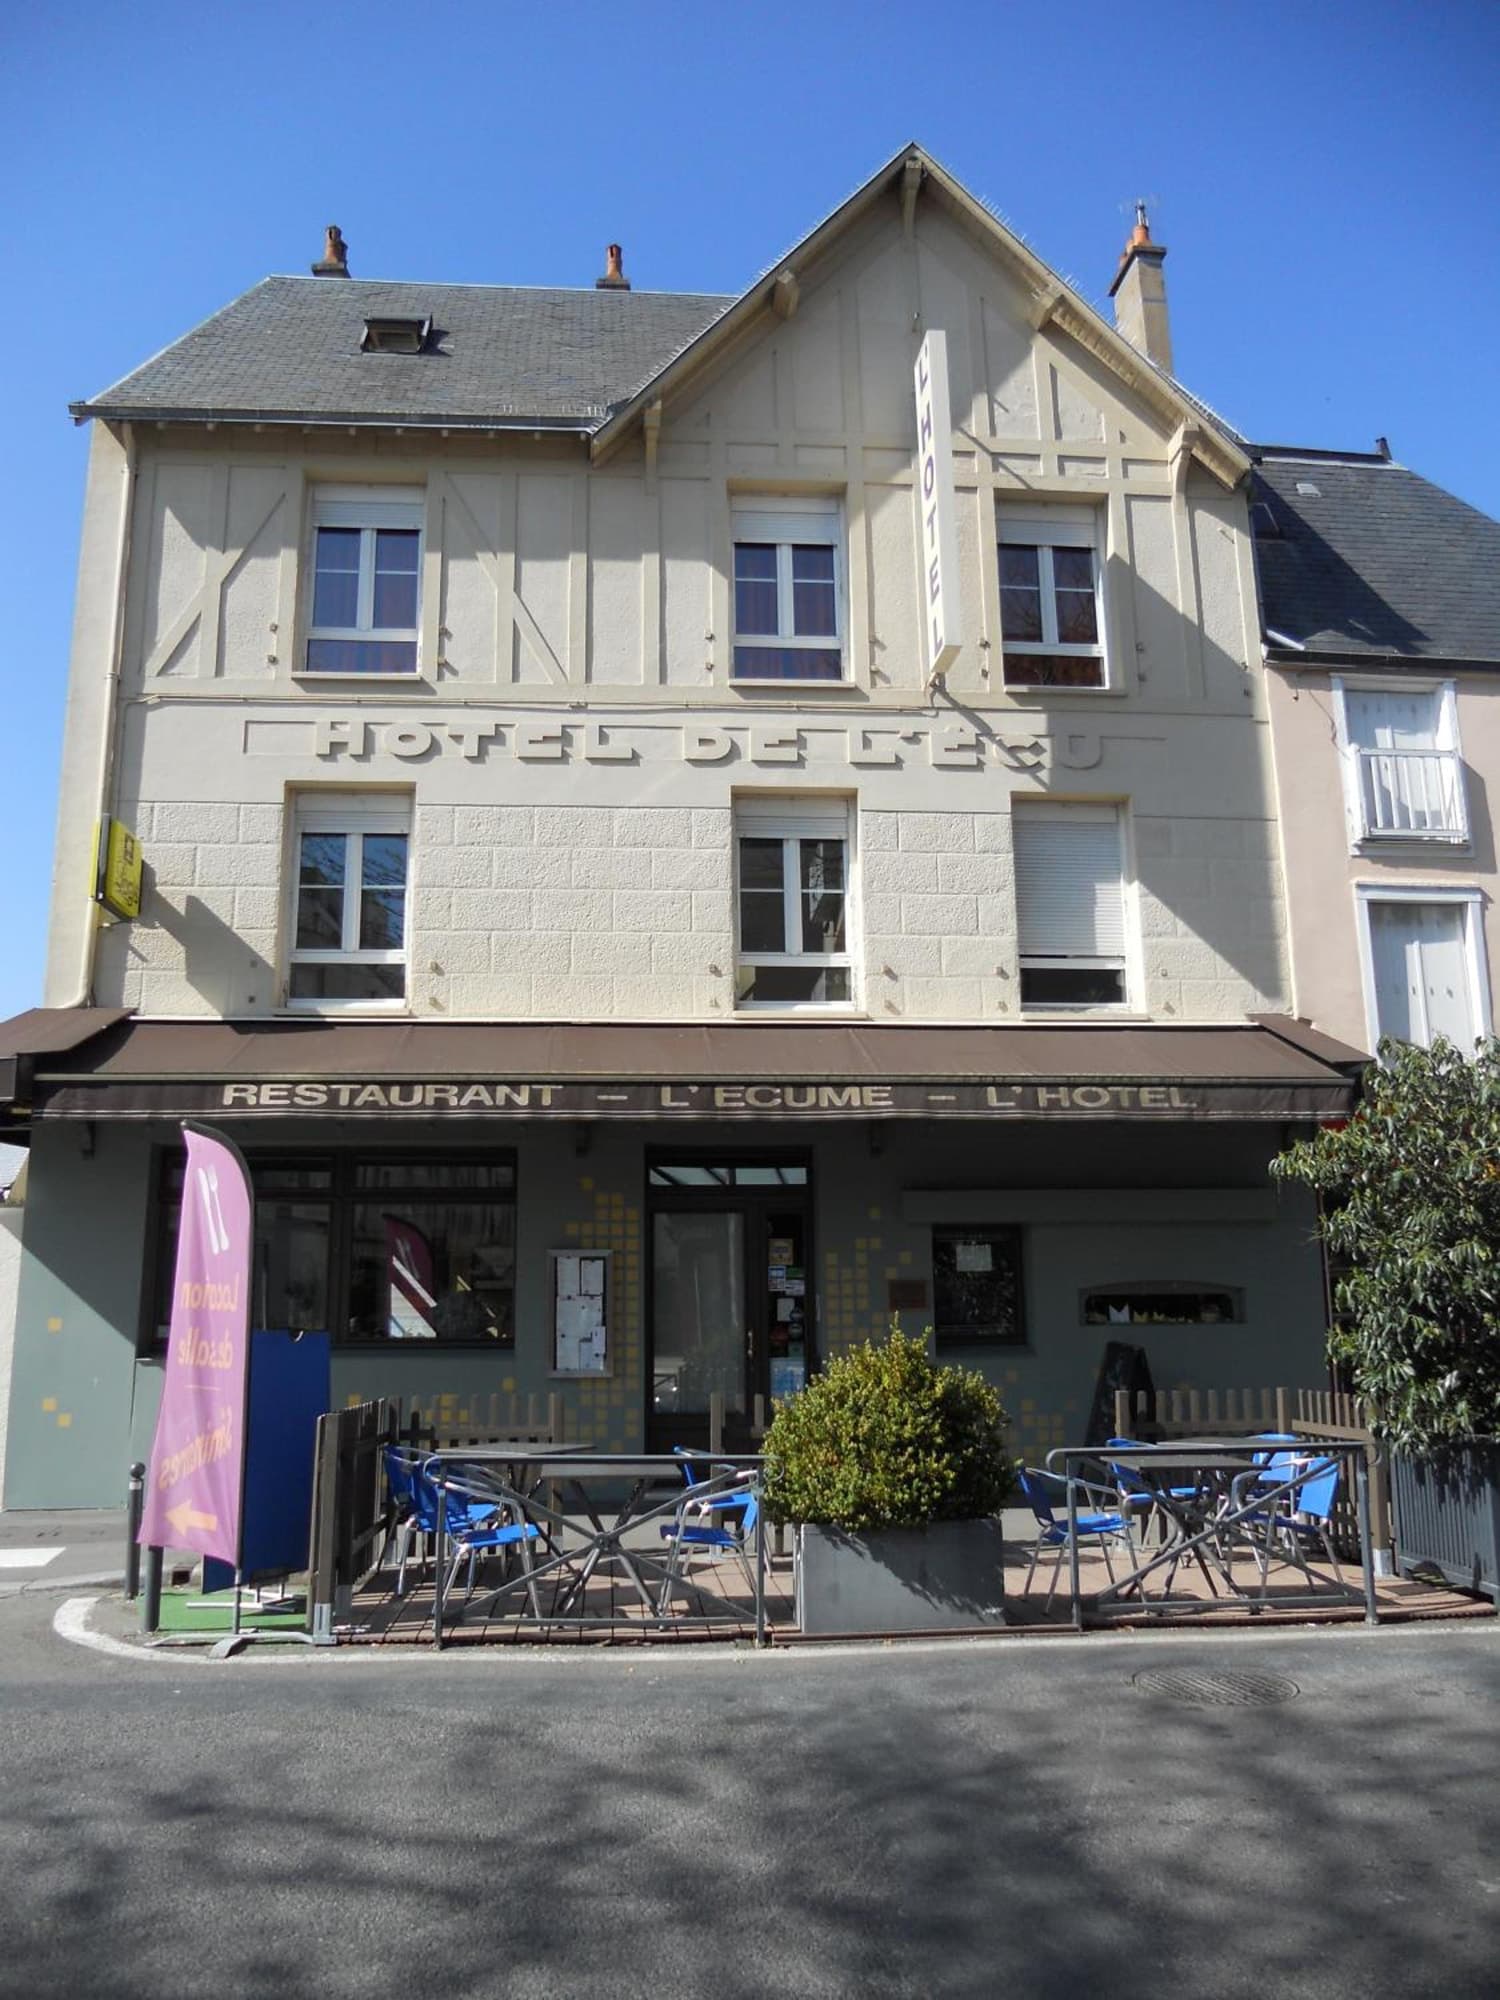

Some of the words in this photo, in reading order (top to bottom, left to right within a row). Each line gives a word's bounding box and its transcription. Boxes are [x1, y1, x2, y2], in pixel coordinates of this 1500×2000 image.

[315, 721, 634, 759] HOTEL
[675, 726, 800, 762] DE
[222, 1083, 563, 1107] RESTAURANT
